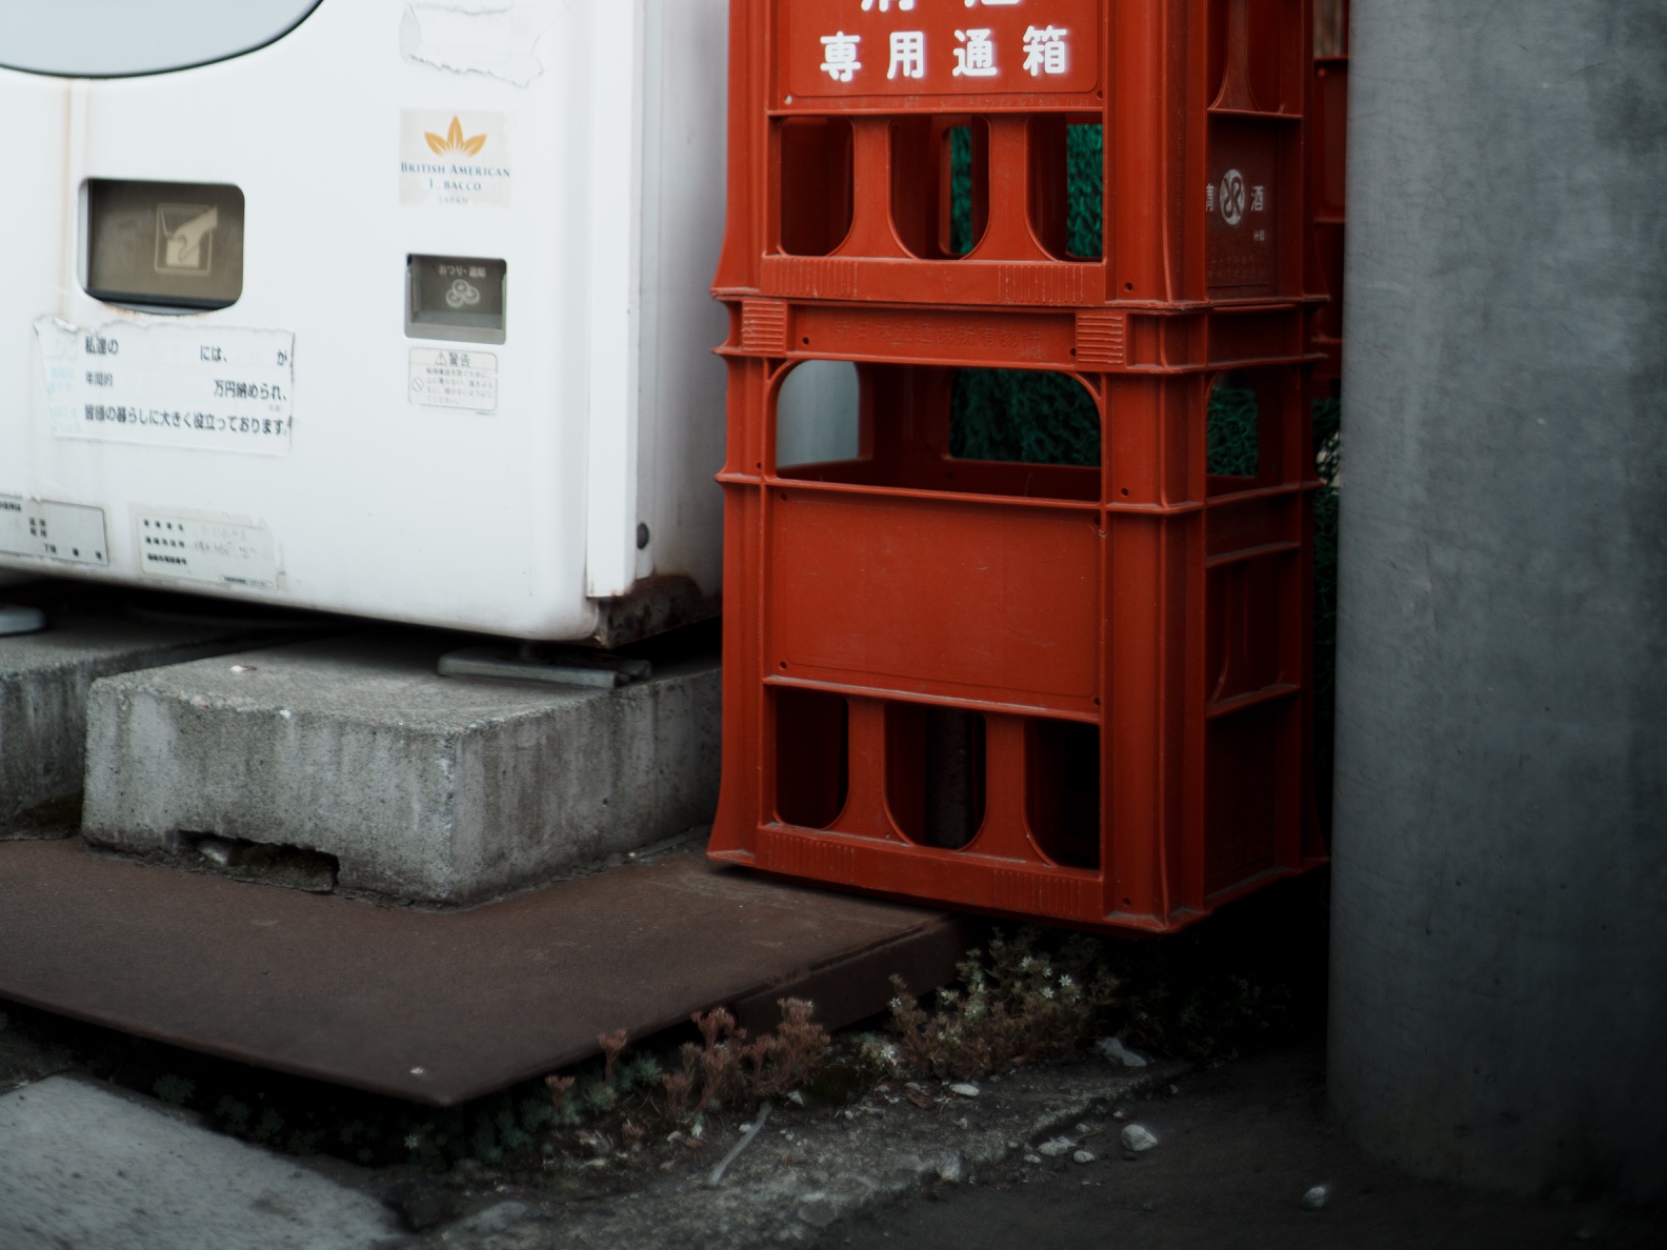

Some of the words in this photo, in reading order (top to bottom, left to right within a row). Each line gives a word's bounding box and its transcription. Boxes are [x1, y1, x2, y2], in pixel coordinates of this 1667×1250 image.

[819, 25, 1068, 83] 専用通箱
[401, 161, 445, 174] BRITISH
[450, 164, 511, 177] AMERICAN
